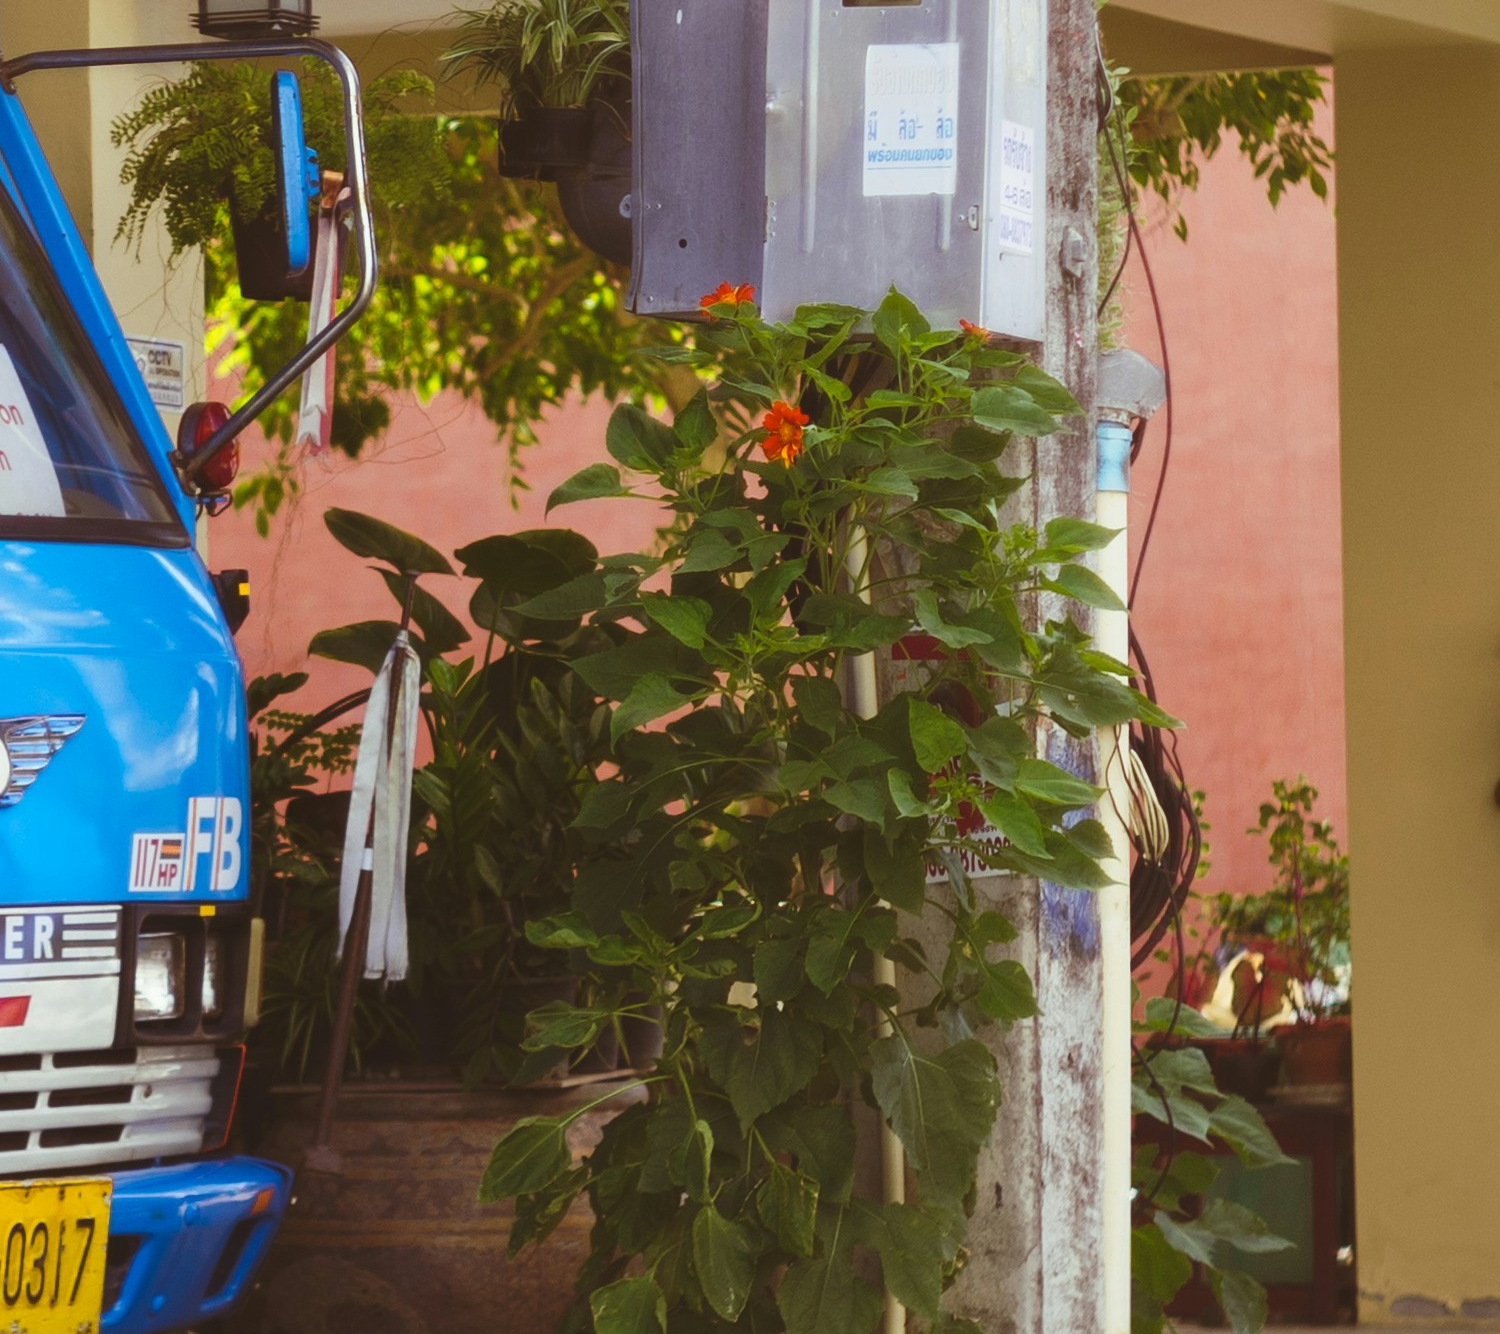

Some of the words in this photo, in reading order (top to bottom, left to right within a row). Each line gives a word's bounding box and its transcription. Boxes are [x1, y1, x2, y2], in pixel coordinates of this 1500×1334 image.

[147, 349, 173, 367] CCTV
[134, 838, 160, 888] 117
[182, 796, 243, 892] FB
[156, 862, 179, 888] HP
